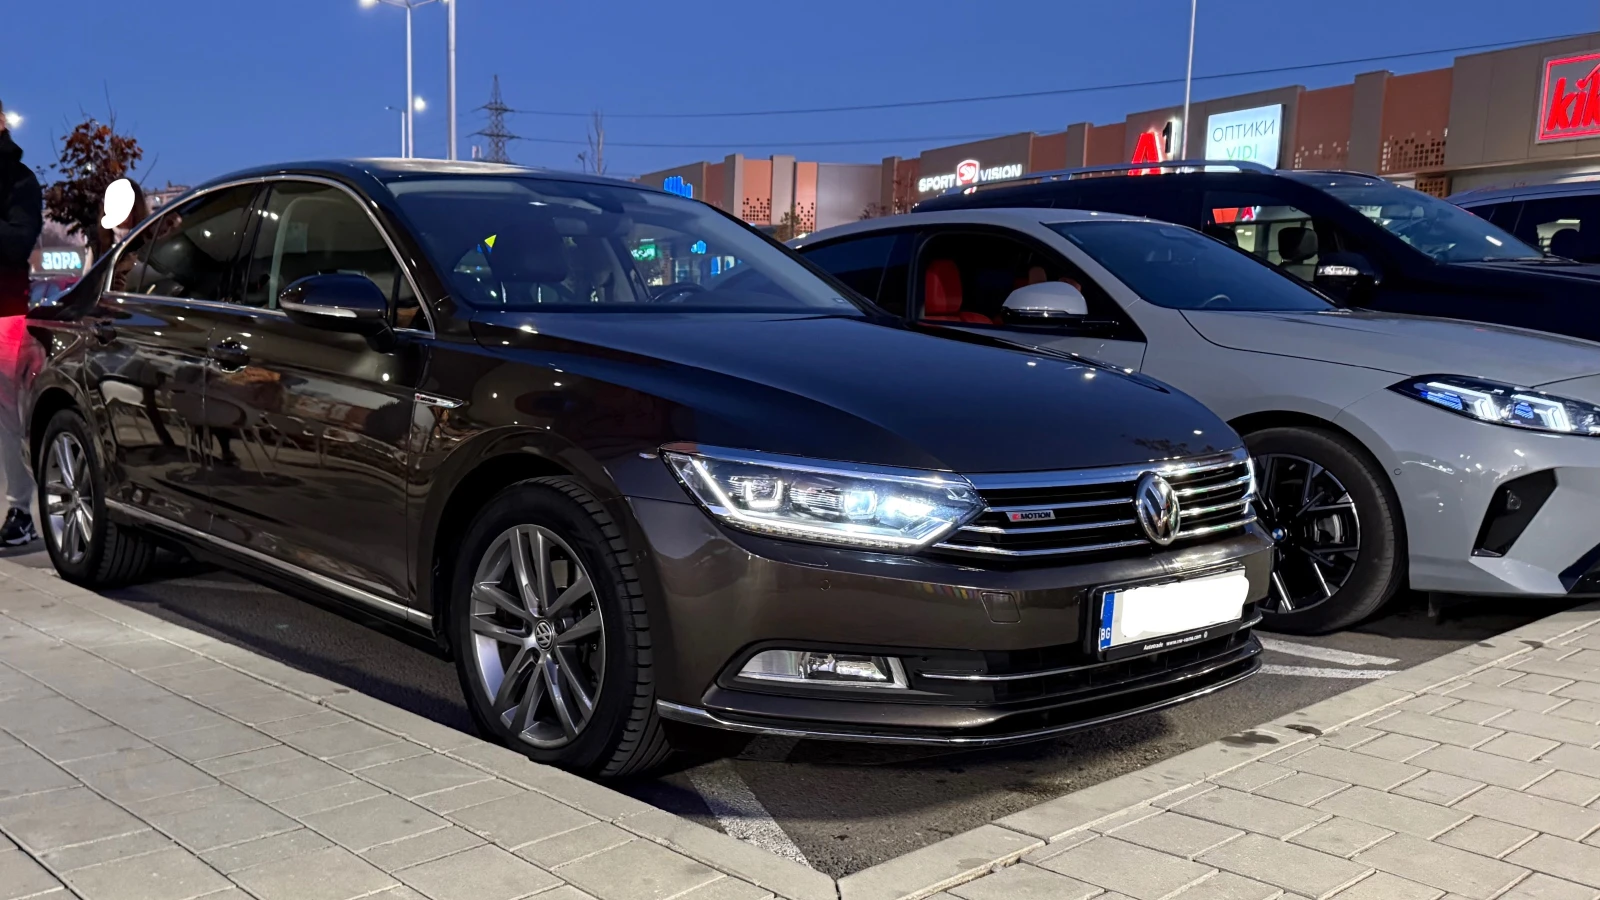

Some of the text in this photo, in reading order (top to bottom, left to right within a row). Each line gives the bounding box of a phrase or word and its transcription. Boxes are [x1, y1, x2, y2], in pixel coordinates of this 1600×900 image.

[1213, 119, 1275, 142] ОПТИКИ
[1227, 144, 1258, 161] VIDI
[919, 164, 1022, 192] SPORT VISION
[1100, 627, 1111, 640] BG
